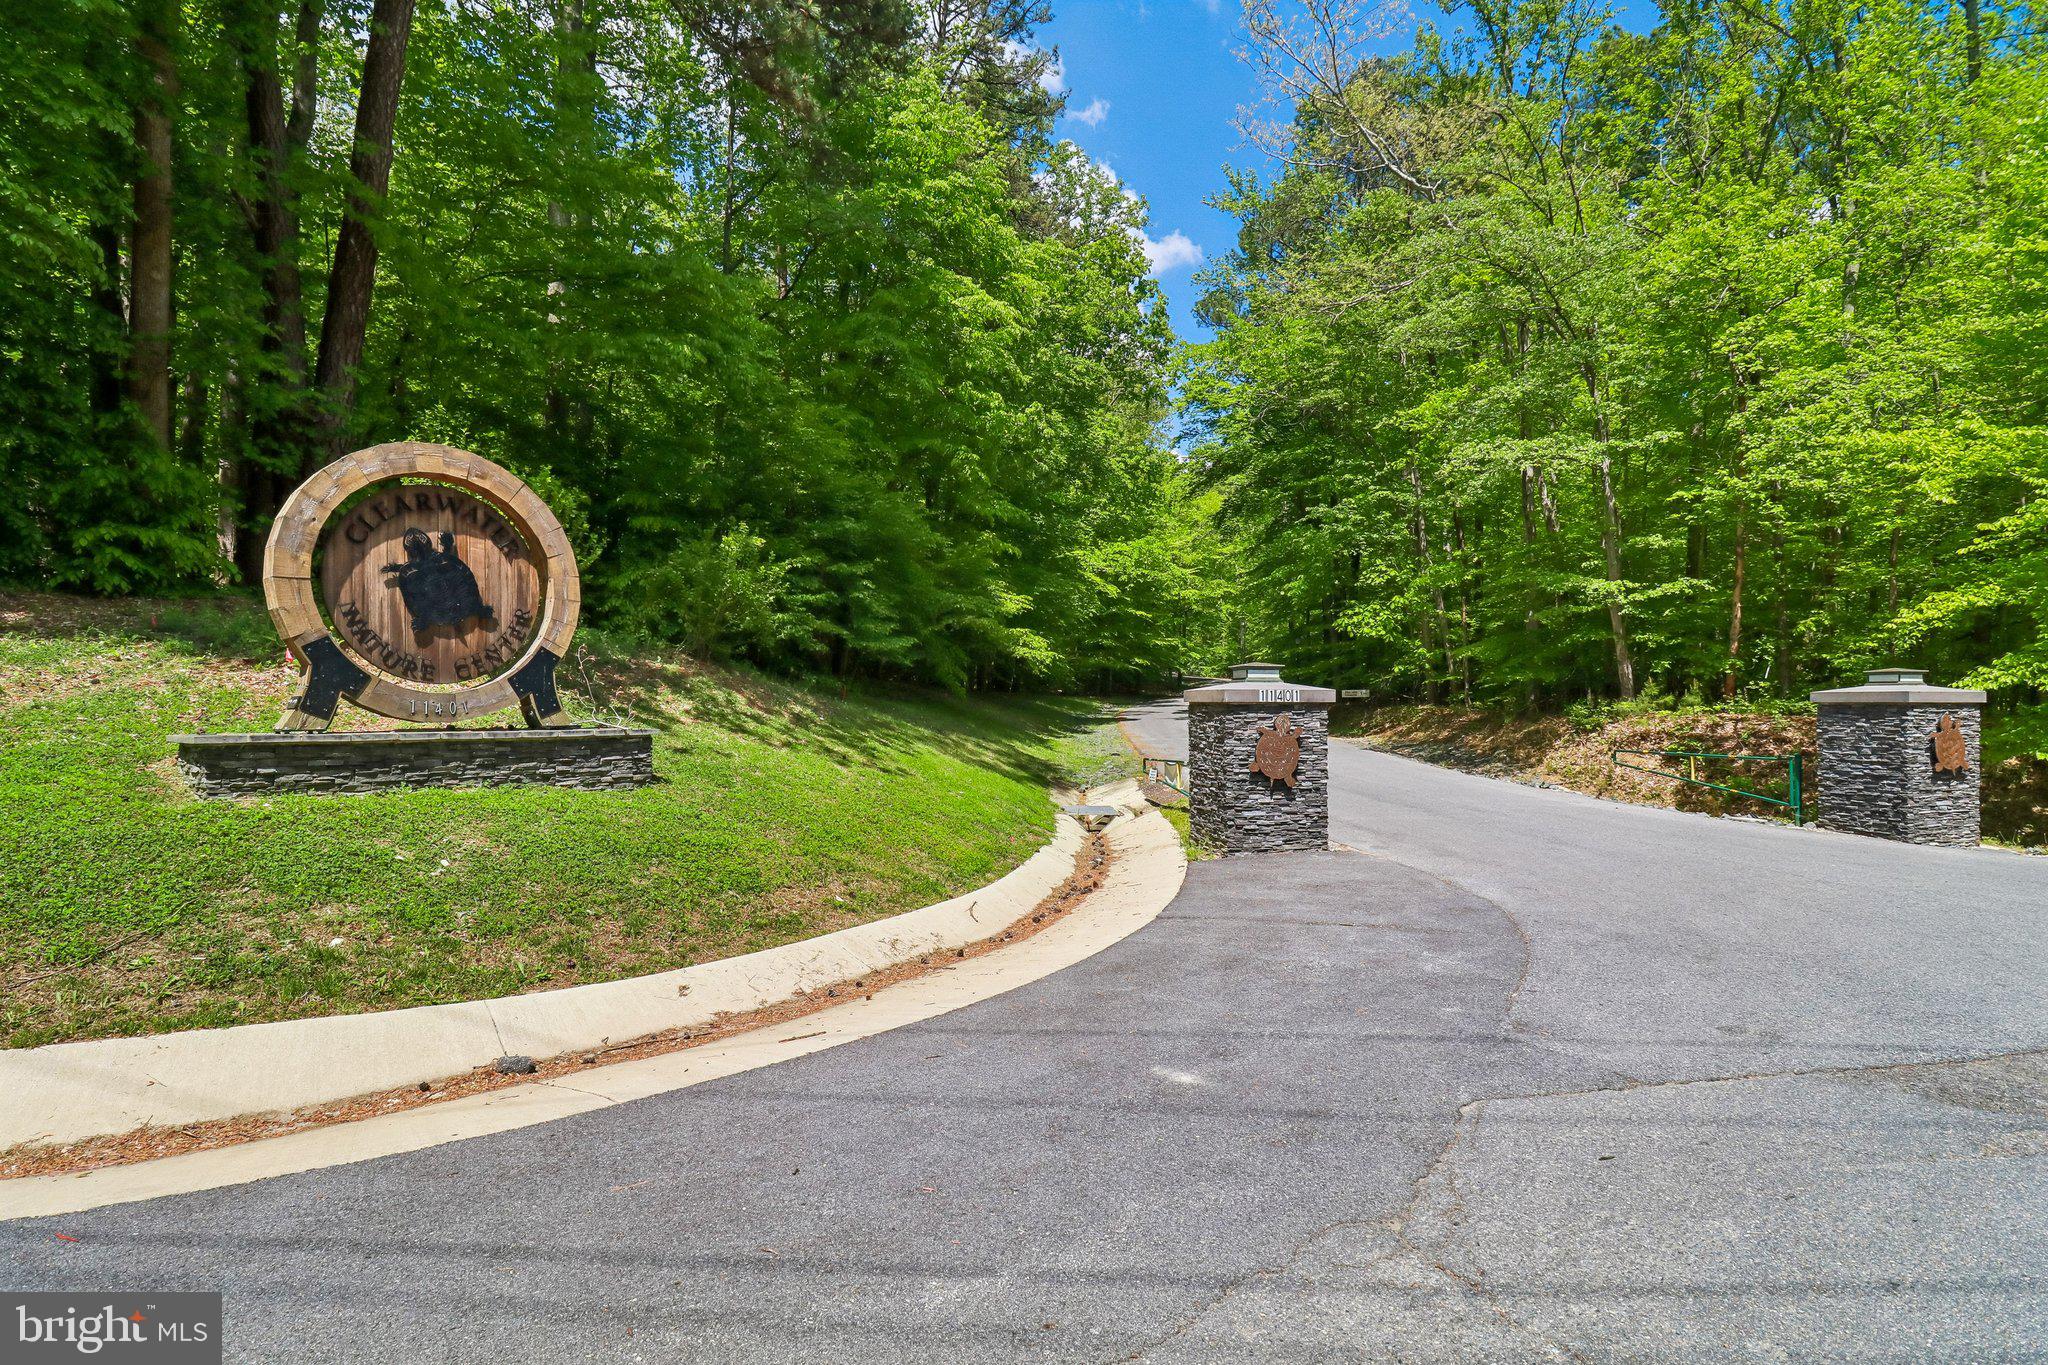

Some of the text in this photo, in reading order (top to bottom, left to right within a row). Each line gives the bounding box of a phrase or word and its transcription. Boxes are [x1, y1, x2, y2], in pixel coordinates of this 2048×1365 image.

[345, 492, 522, 563] CLEARWATER
[339, 601, 532, 681] NATURE CENTER
[409, 699, 469, 716] 11401
[1259, 690, 1300, 702] 11401
